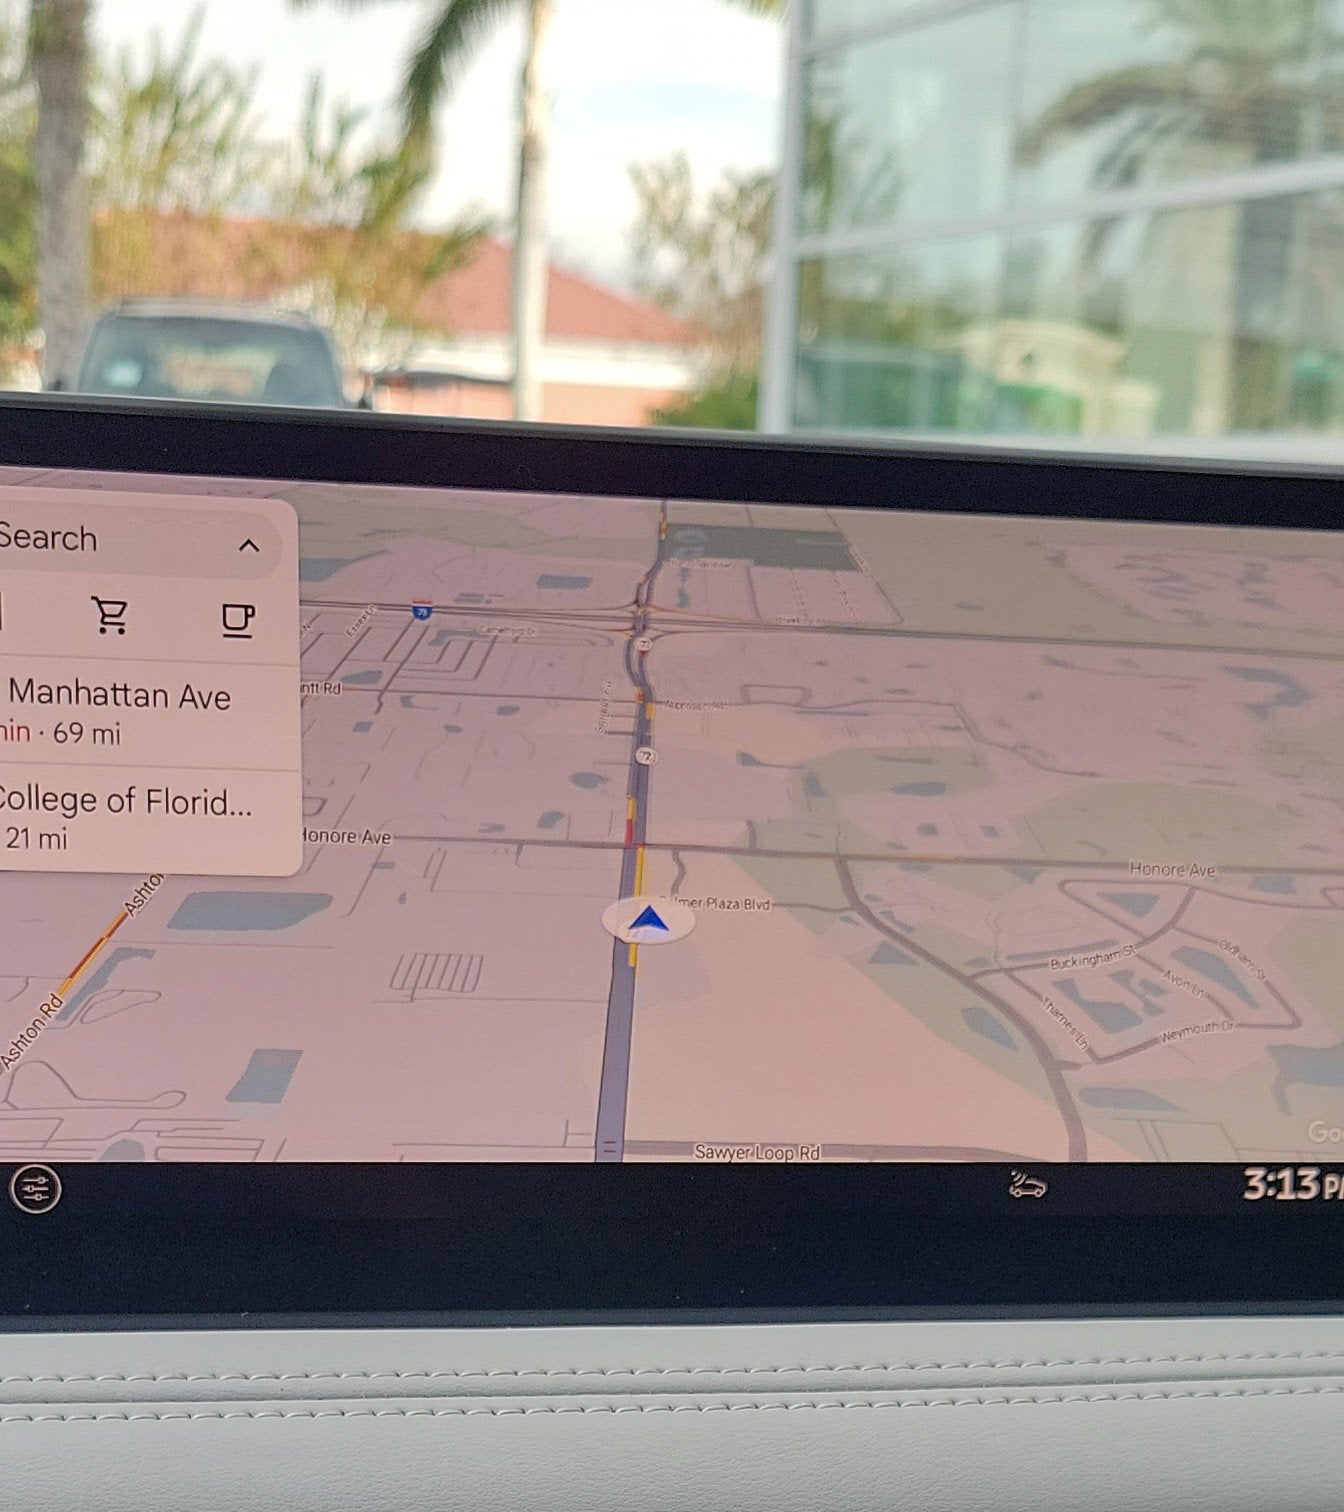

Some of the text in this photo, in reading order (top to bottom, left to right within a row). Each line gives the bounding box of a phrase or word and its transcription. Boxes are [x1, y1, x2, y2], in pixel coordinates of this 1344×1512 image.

[9, 677, 169, 709] Manhattan
[178, 684, 232, 711] Ave
[300, 682, 342, 696] ntt Rd
[53, 722, 84, 744] 69
[93, 721, 121, 746] mi
[107, 786, 136, 814] of
[5, 826, 31, 850] 21
[39, 828, 67, 851] mi
[361, 829, 392, 845] Ave
[1130, 860, 1217, 878] Honore Ave
[706, 896, 740, 911] Plaza
[744, 898, 771, 911] Blvd
[1051, 949, 1121, 970] Buckingham
[1162, 969, 1190, 990] Avon
[0, 992, 64, 1071] Ashton Rd
[694, 1143, 821, 1163] Sawyer Loop Rd
[1242, 1165, 1322, 1200] 3:13
